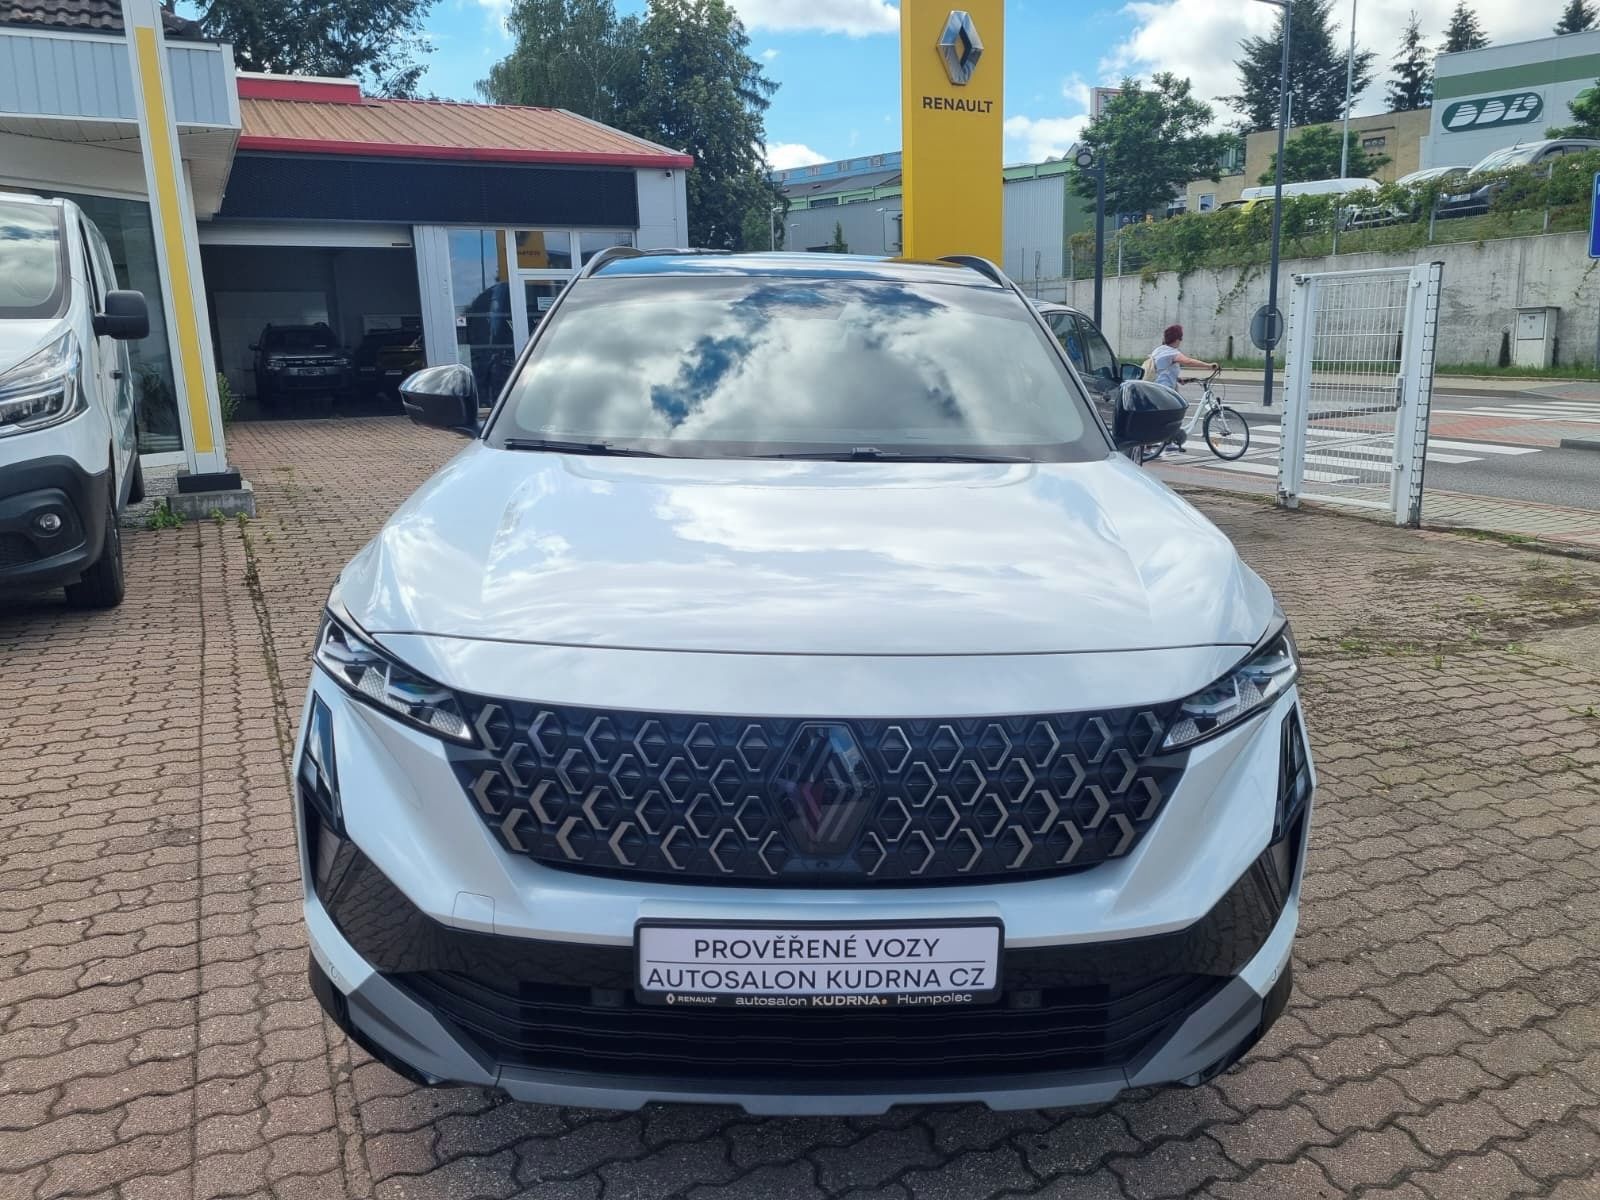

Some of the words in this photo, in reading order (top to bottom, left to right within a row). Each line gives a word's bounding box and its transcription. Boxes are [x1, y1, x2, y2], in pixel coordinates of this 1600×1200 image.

[922, 96, 993, 113] RENAULT
[694, 935, 857, 959] PROVĚŘENÉ
[865, 938, 941, 958] VOZY
[646, 968, 817, 989] AUTOSALON
[826, 968, 942, 989] KUDRNA
[949, 967, 986, 987] CZ
[677, 995, 717, 1004] RENAULT
[735, 996, 807, 1006] autosalon
[897, 992, 973, 1006] Humpolec
